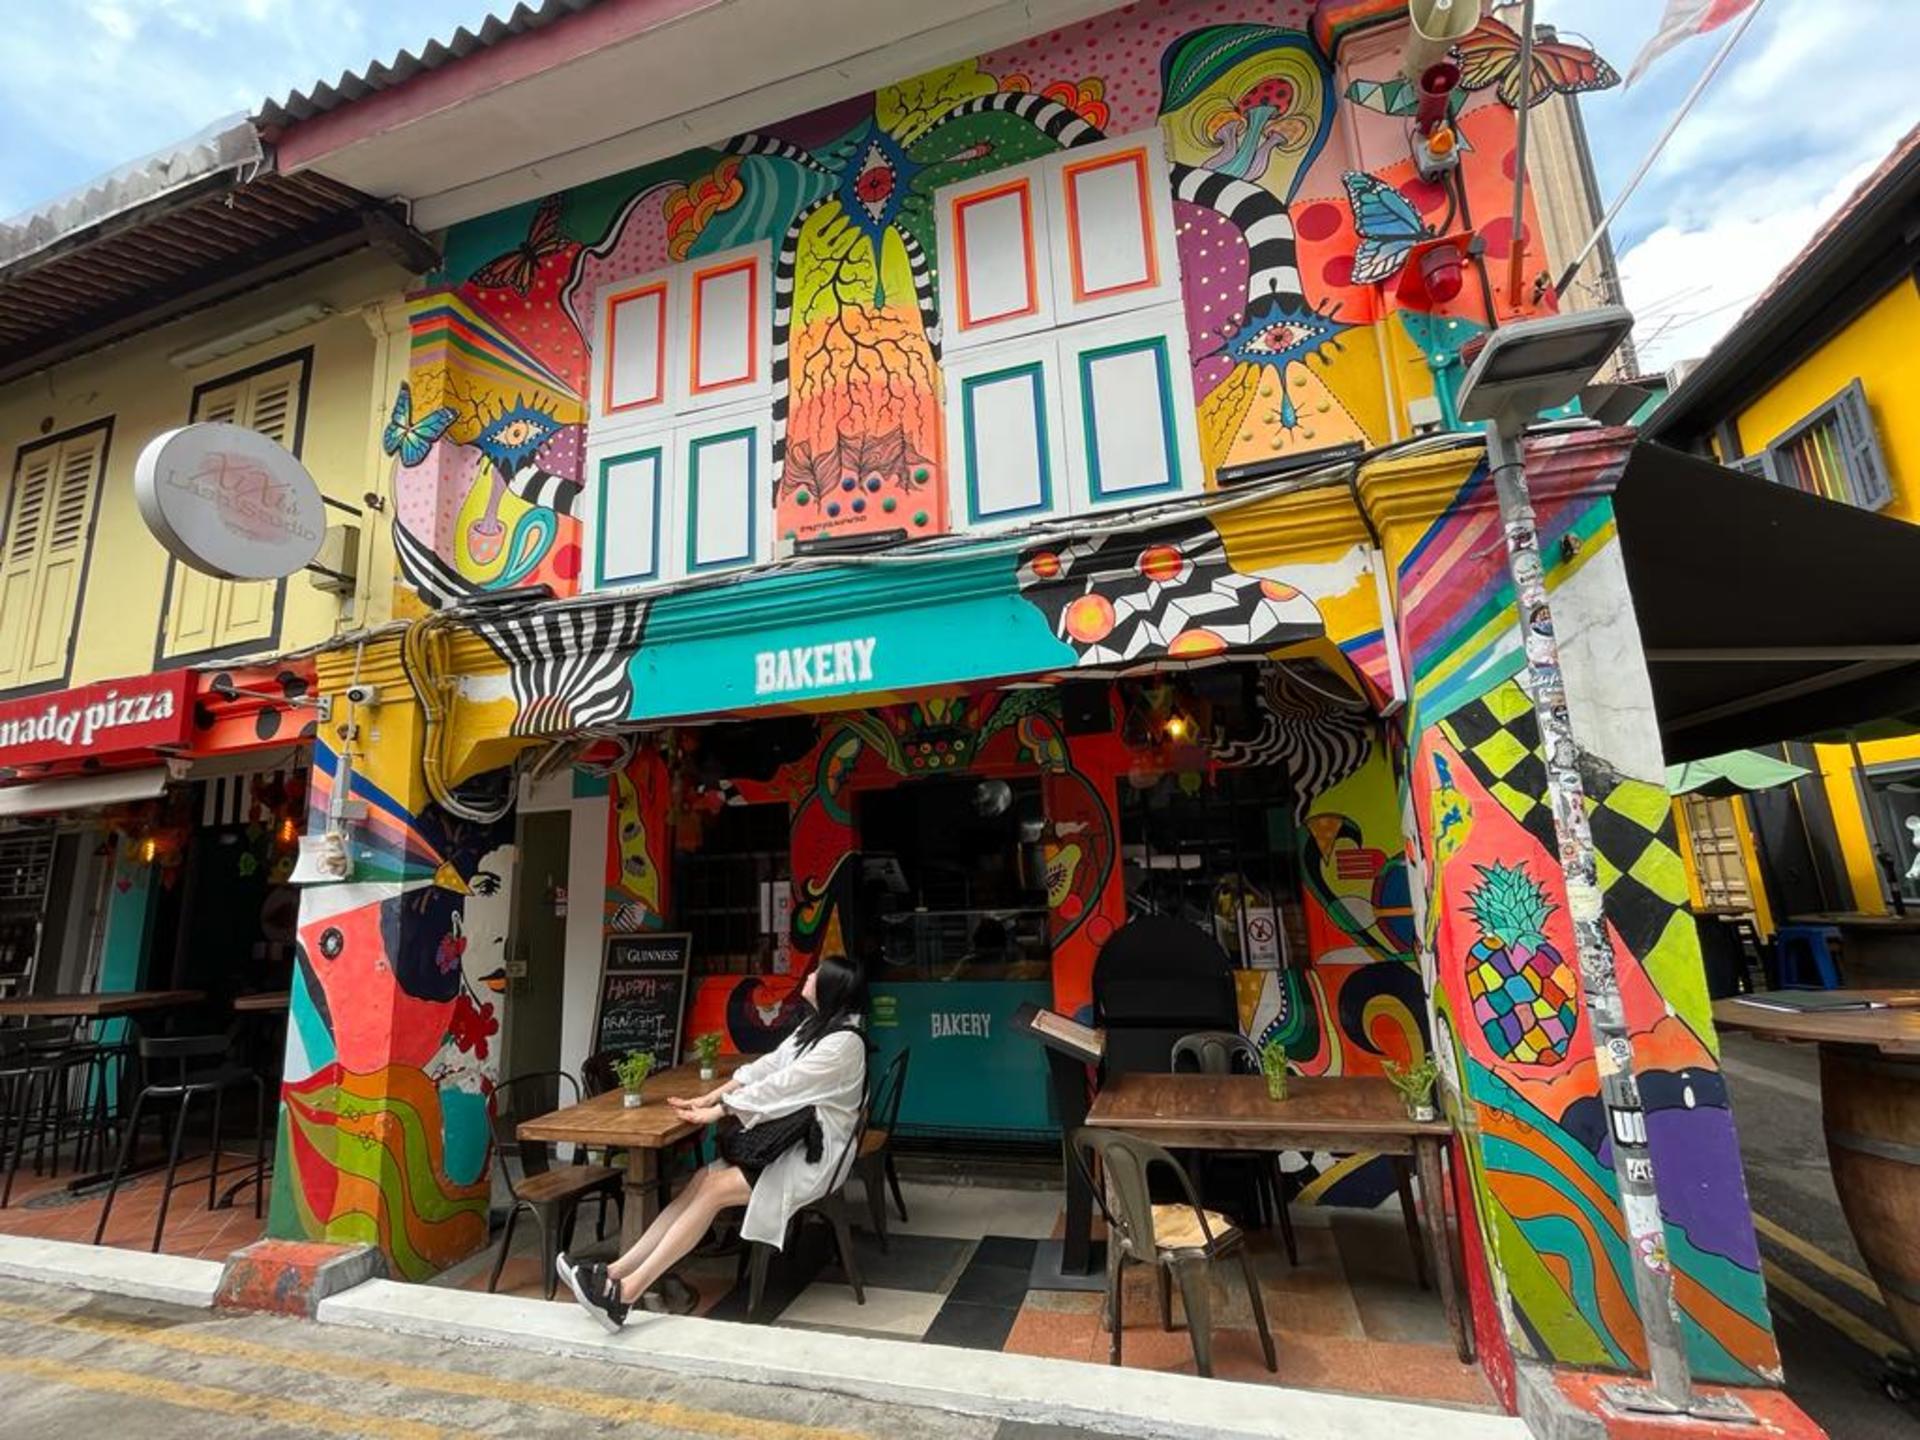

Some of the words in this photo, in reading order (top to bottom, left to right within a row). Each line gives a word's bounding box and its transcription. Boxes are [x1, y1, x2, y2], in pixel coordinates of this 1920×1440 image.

[755, 637, 876, 694] BAKERY
[81, 690, 174, 745] pizza
[627, 949, 679, 961] GUINNESS
[931, 1013, 991, 1038] BAKERY
